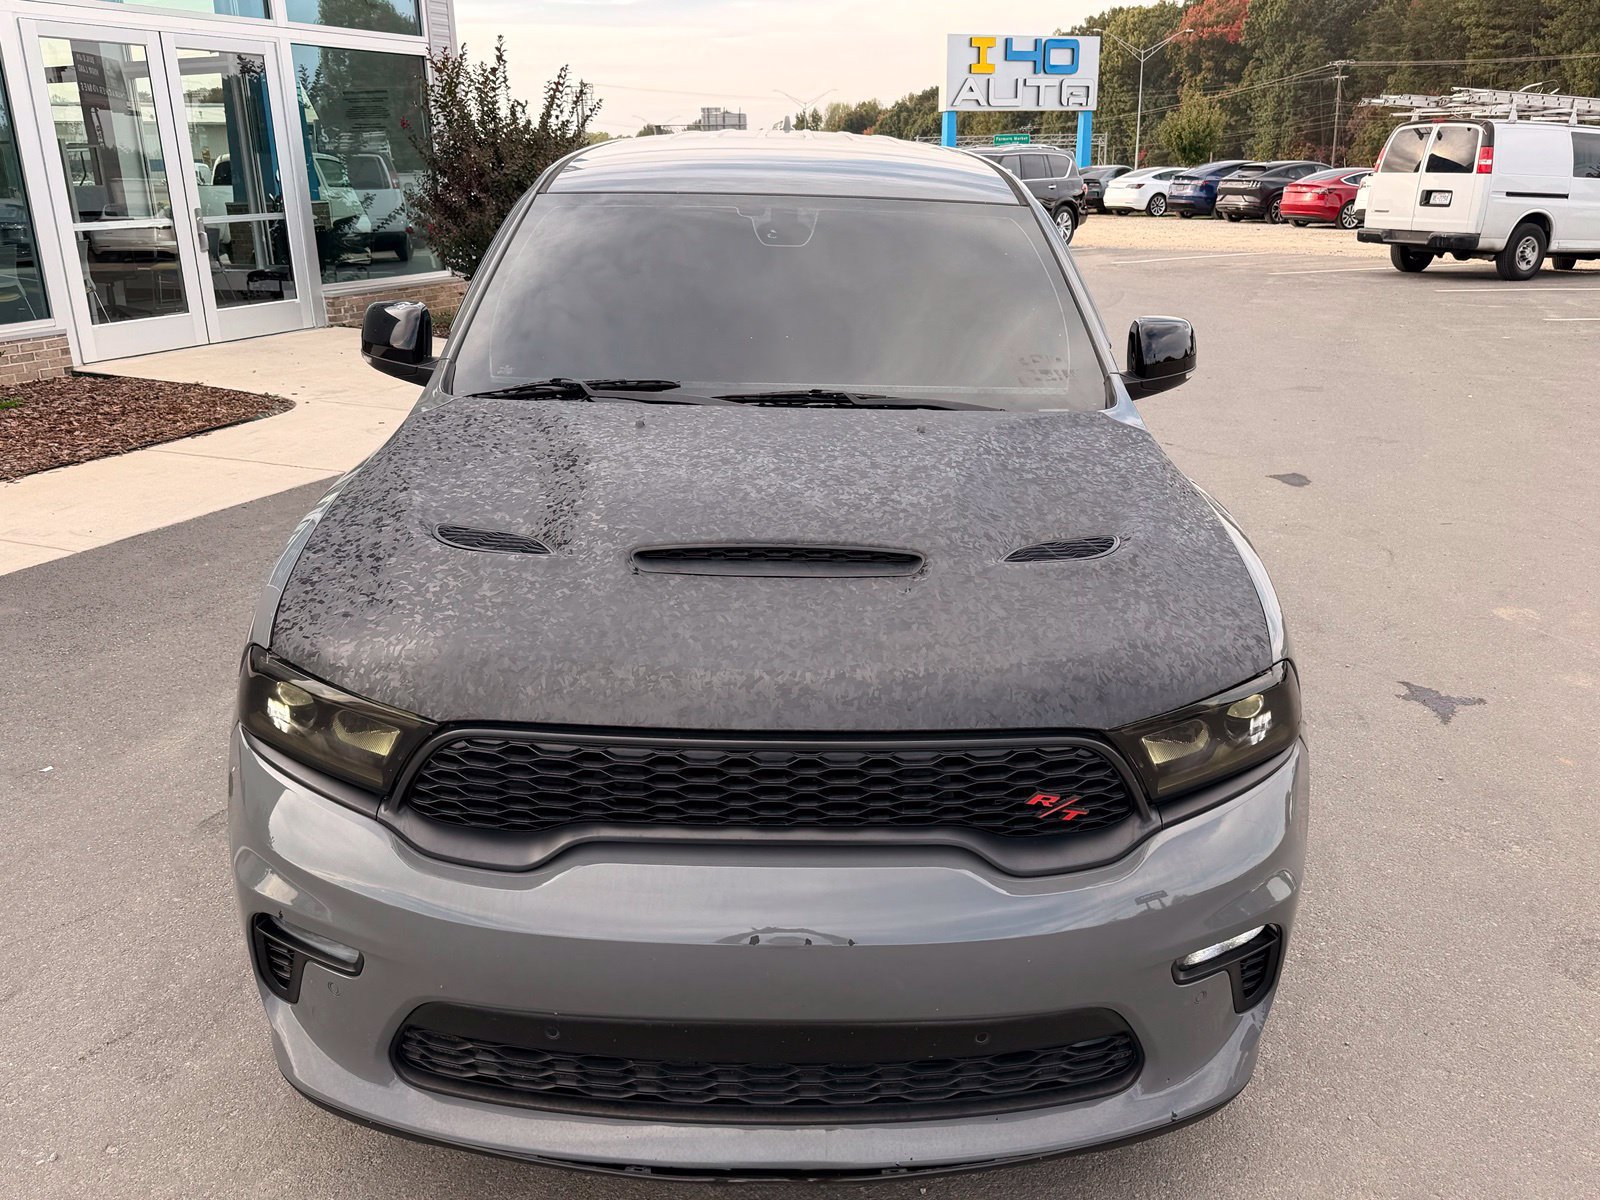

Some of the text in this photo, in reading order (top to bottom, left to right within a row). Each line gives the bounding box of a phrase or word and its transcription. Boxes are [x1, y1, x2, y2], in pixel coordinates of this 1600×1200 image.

[969, 37, 1080, 75] I 40
[951, 77, 1096, 107] AUTO
[1025, 793, 1089, 820] R/T
